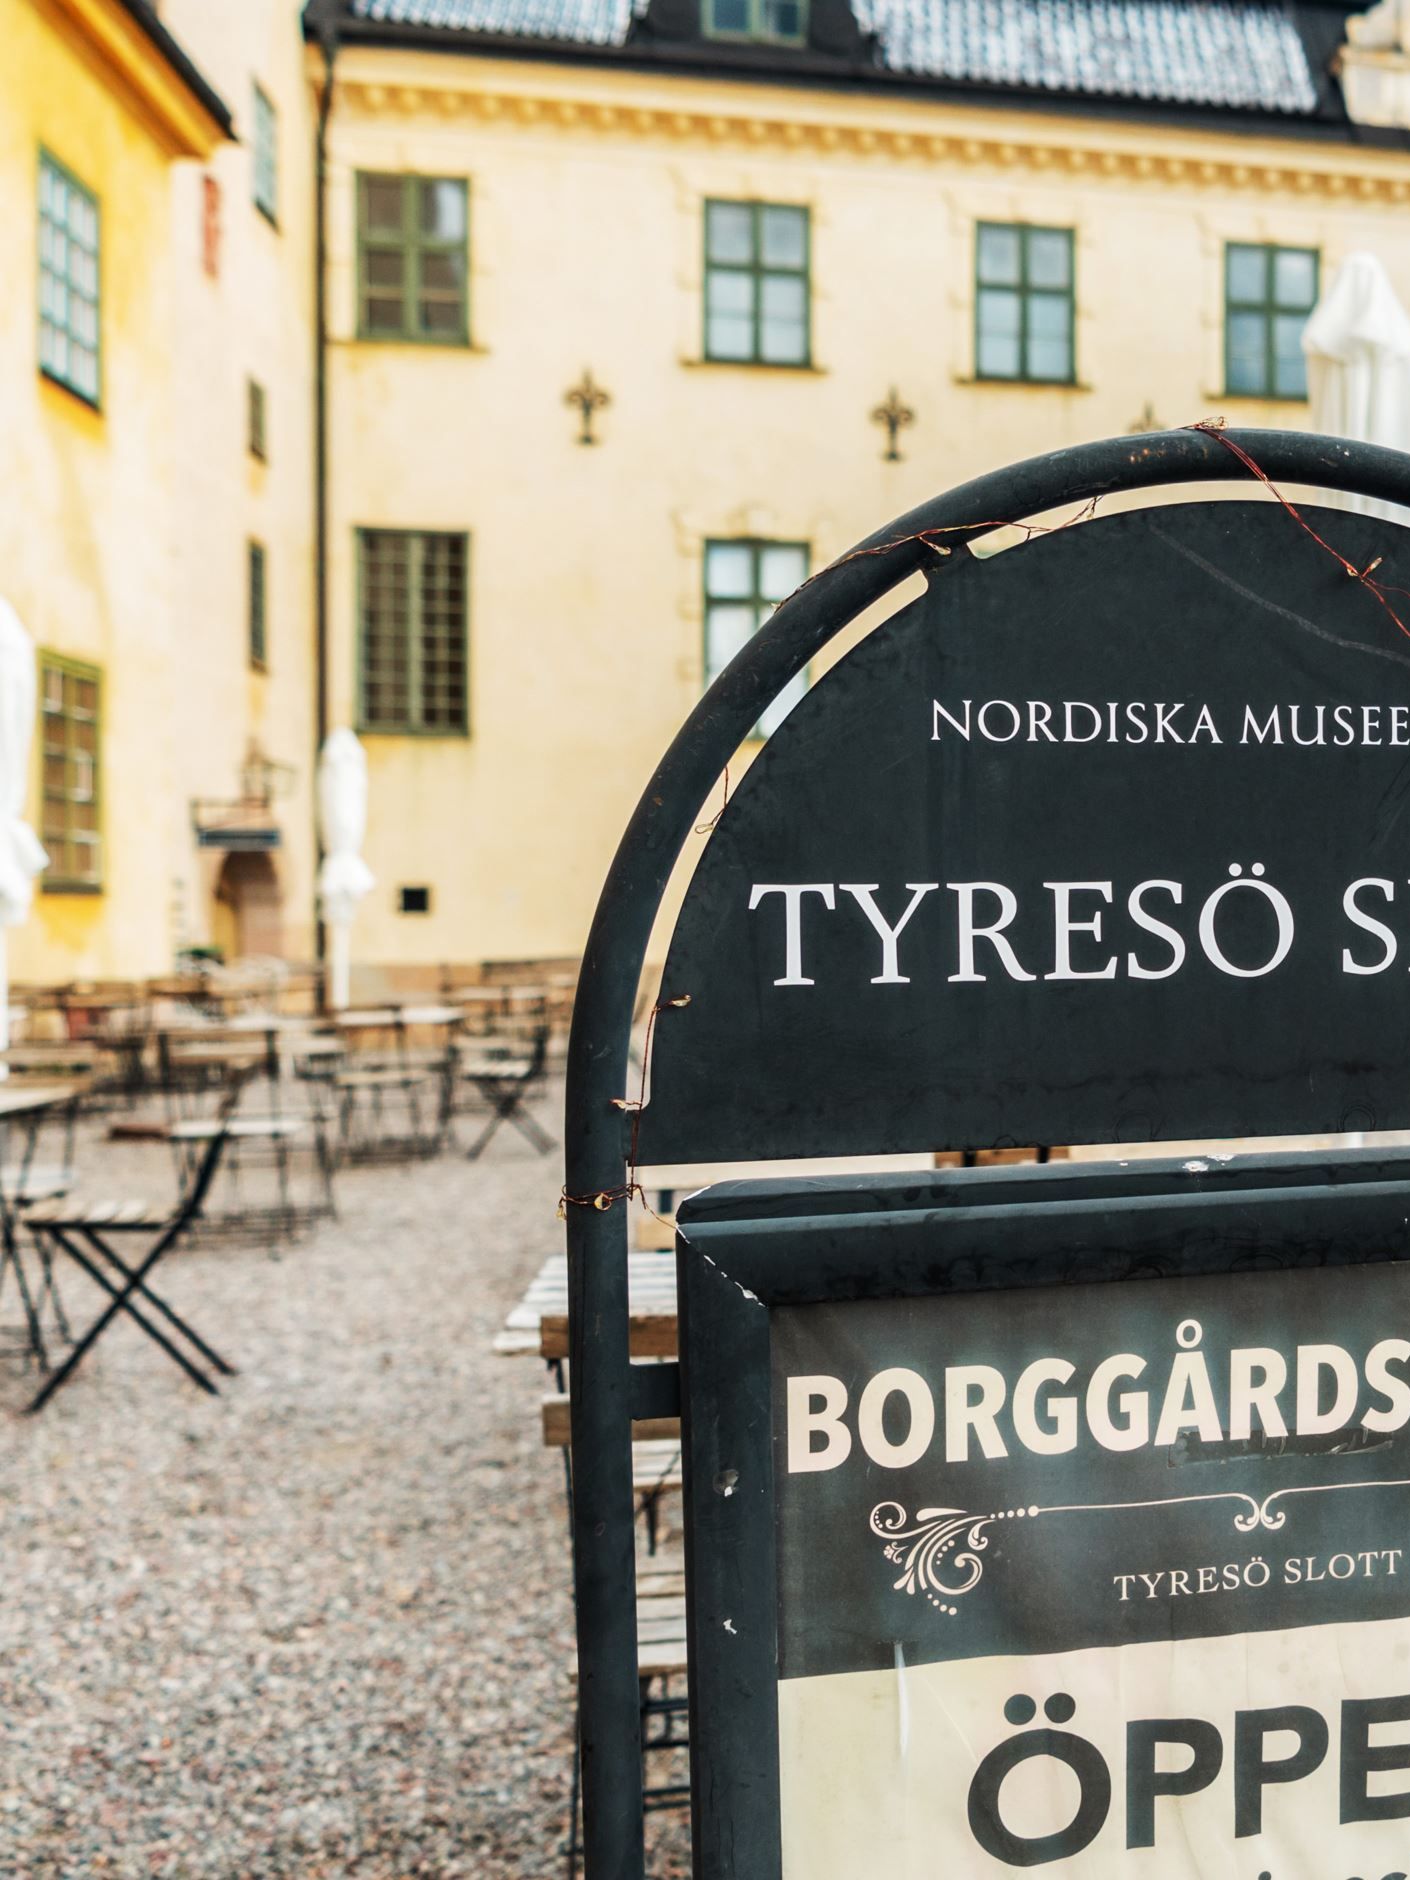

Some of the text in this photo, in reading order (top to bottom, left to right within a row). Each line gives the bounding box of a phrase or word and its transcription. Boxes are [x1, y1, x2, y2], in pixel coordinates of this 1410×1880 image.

[930, 699, 1224, 745] NORDISKA
[748, 862, 1295, 986] TYRESÖ
[1113, 1549, 1403, 1601] TYRESÖ SLOTT
